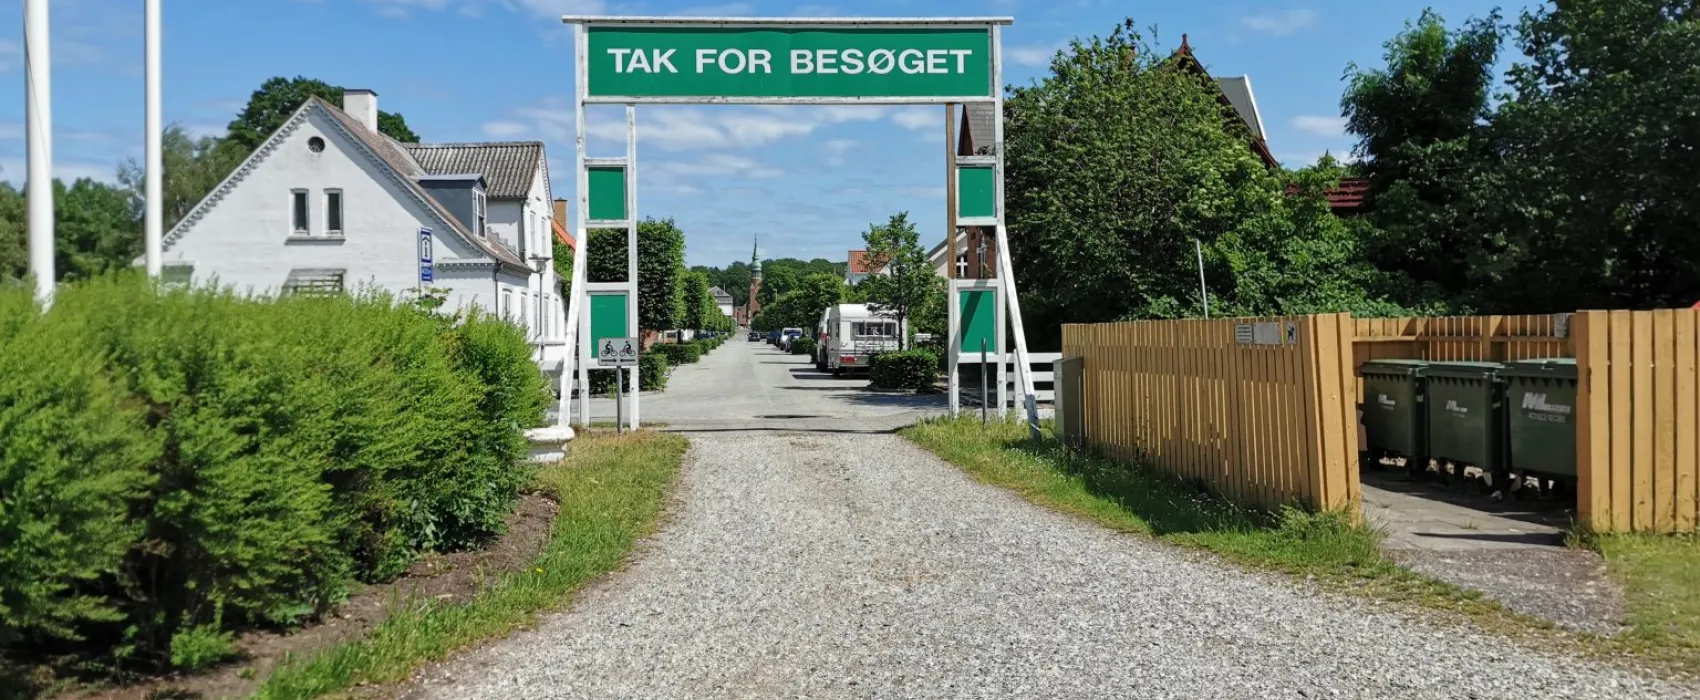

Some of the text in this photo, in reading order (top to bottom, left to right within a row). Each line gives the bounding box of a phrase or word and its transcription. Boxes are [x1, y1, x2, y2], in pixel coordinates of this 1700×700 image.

[607, 48, 973, 75] TAK FOR BESØGET
